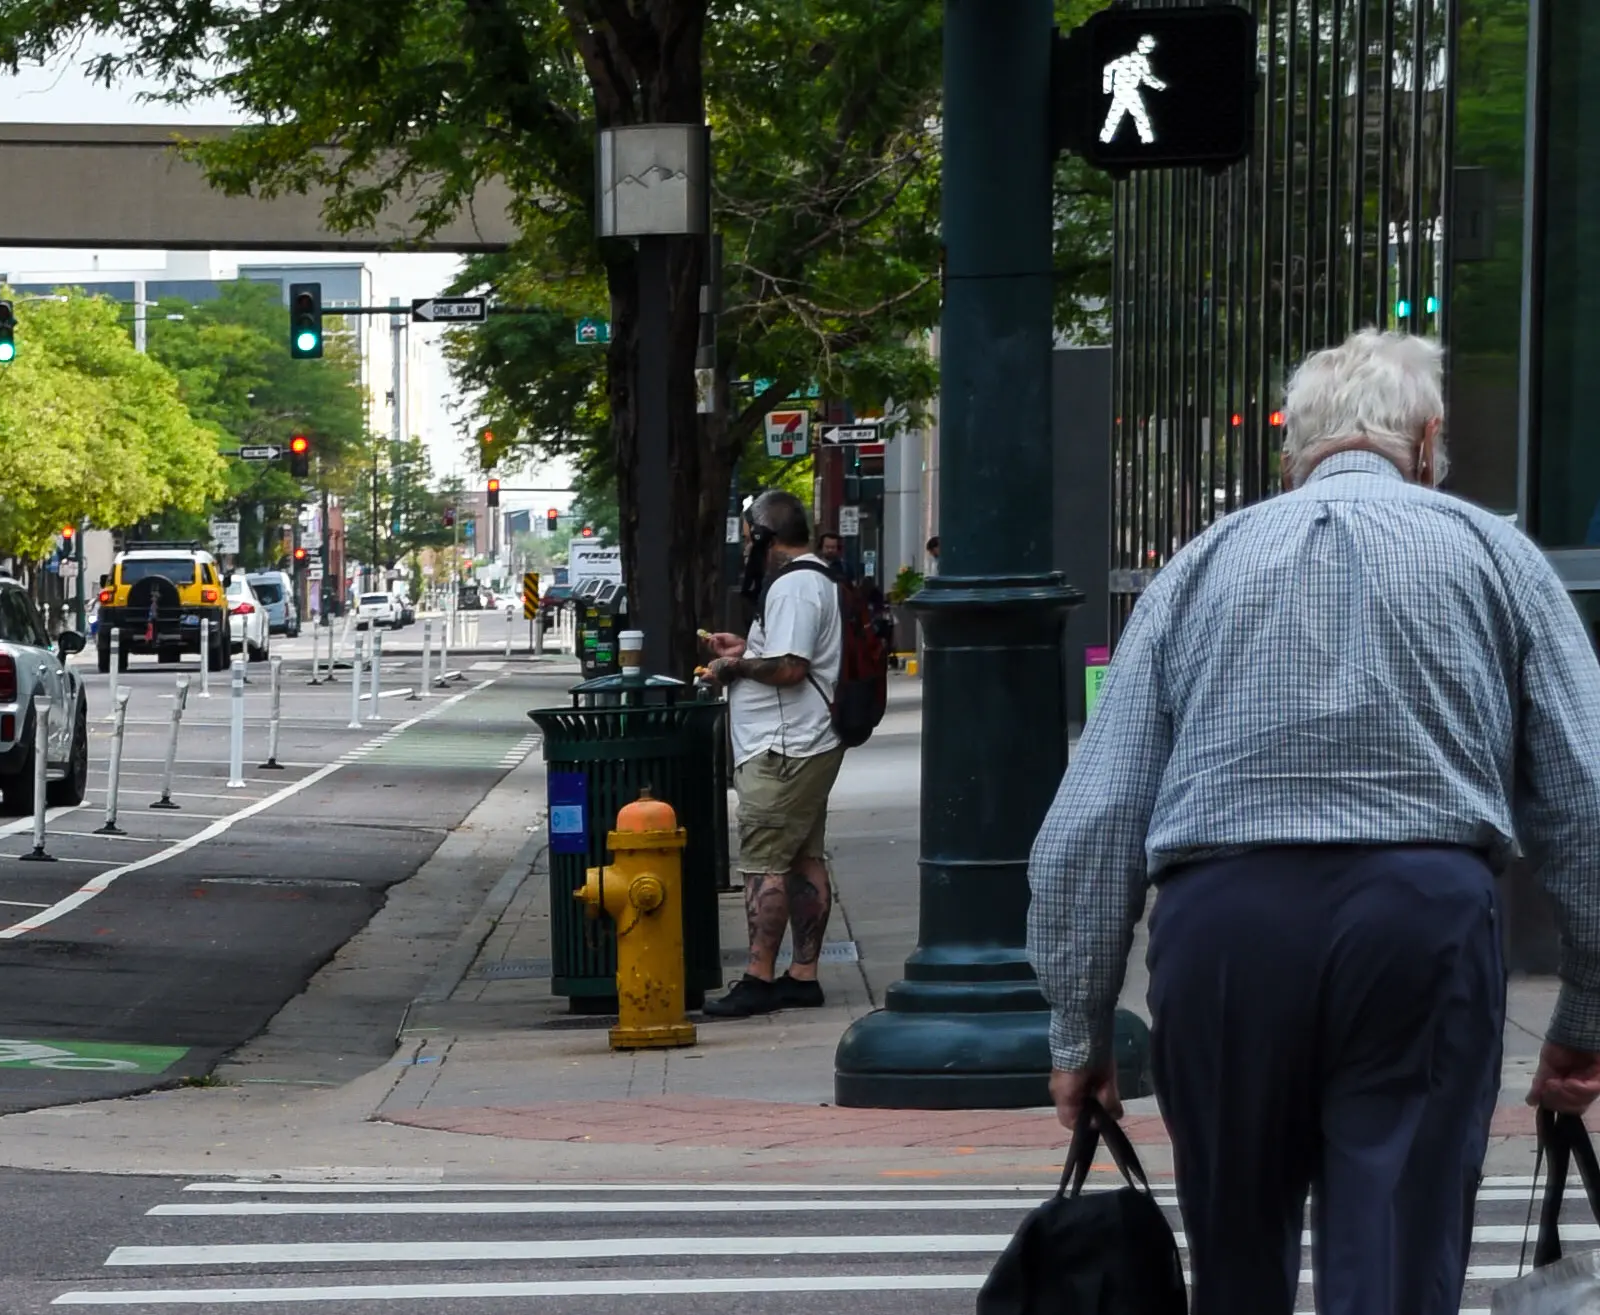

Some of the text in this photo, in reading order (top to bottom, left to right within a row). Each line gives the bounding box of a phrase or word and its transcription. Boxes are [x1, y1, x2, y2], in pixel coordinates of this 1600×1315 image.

[433, 305, 477, 315] ONE WAY
[771, 413, 803, 455] 7
[838, 431, 852, 439] ONE
